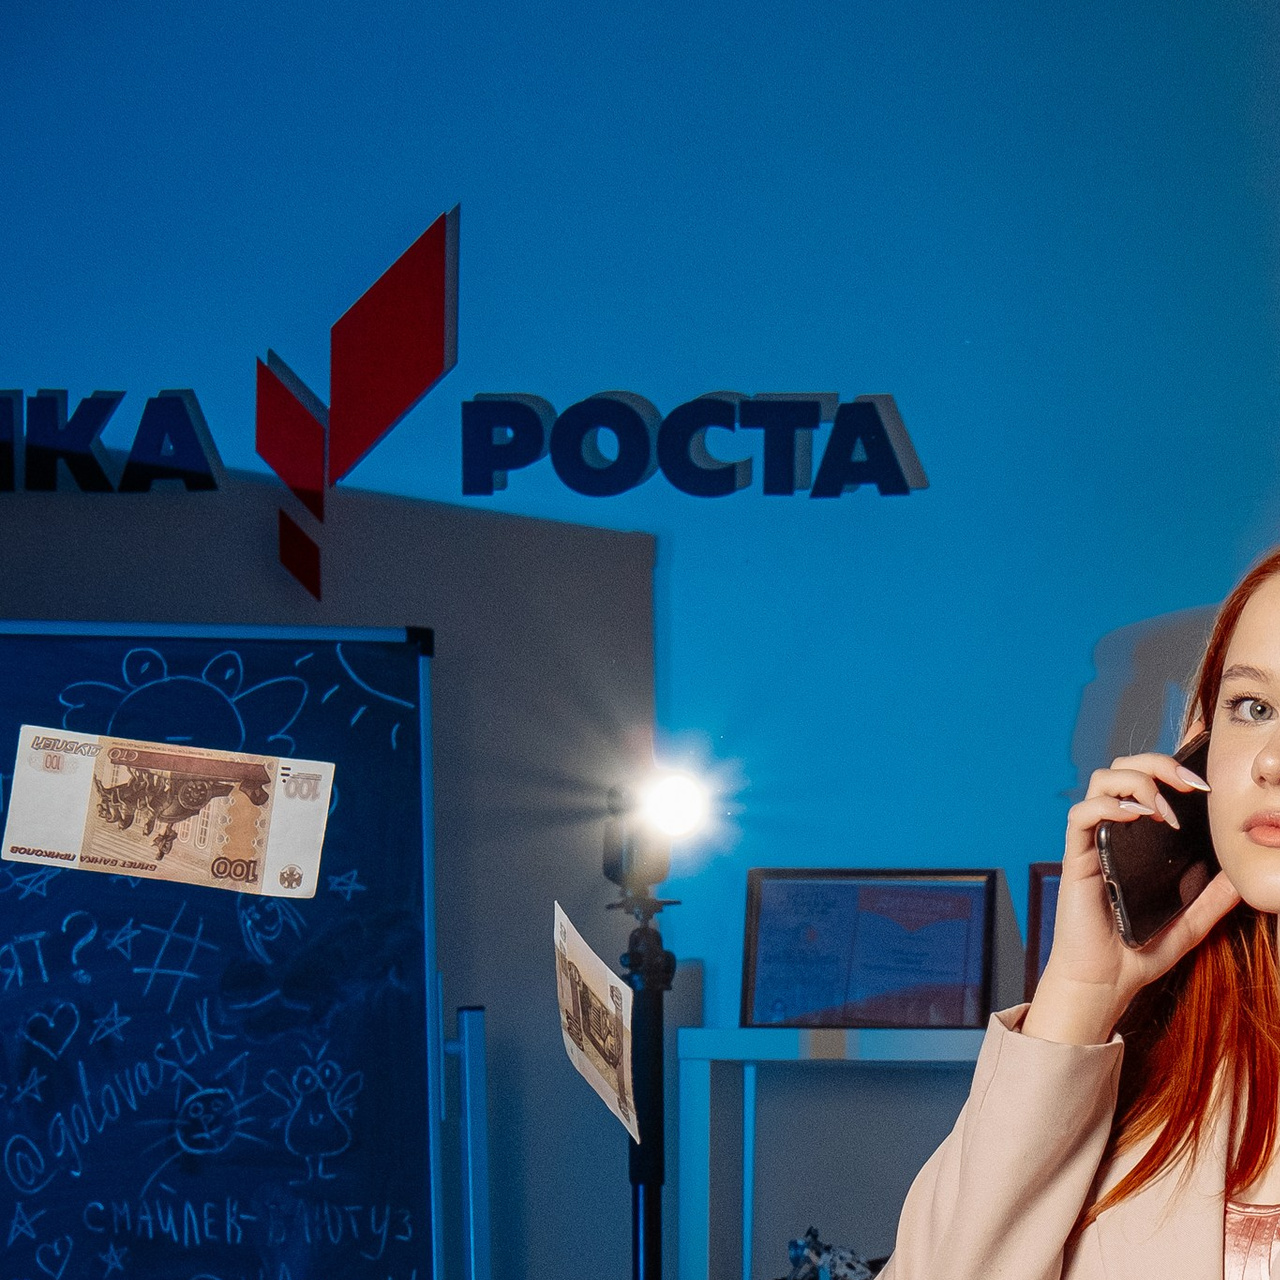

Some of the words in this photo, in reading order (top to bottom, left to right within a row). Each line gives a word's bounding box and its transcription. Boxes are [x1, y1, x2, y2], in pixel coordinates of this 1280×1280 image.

[0, 391, 222, 492] КА
[462, 393, 920, 498] РОСТА
[211, 856, 258, 884] 100
